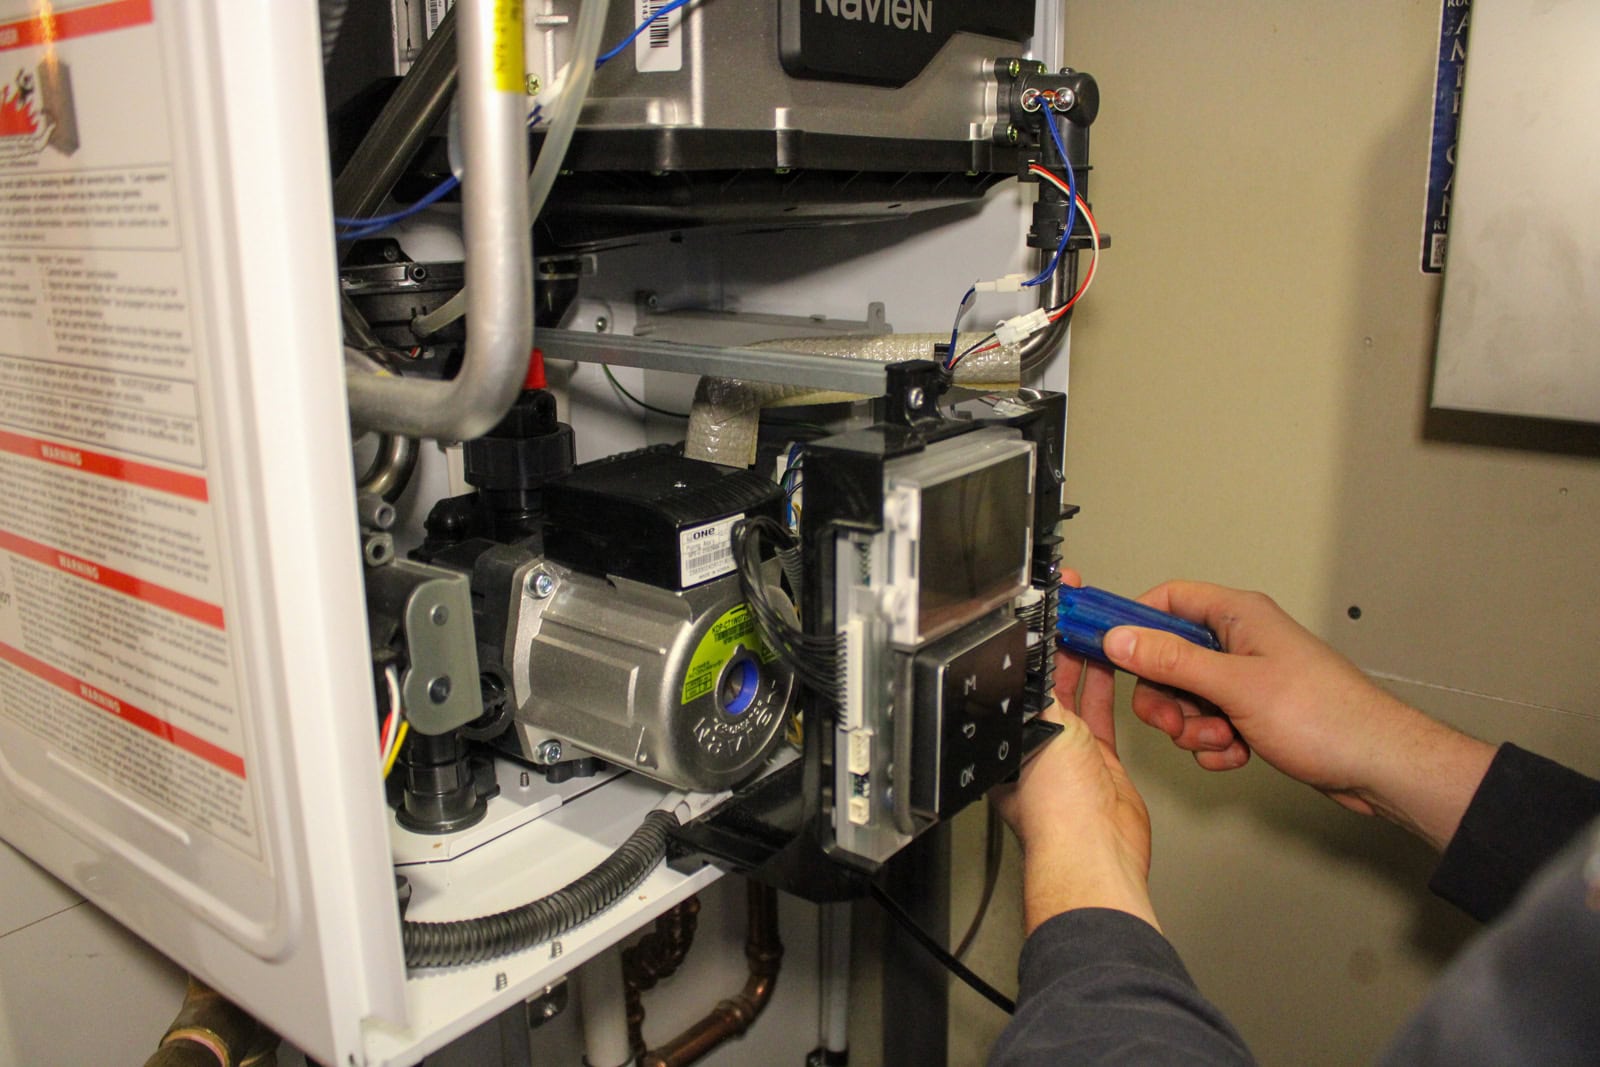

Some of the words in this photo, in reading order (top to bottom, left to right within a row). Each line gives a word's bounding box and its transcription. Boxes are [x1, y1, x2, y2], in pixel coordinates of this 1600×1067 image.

[41, 445, 82, 466] WARNING
[58, 555, 99, 579] WARNING
[80, 684, 121, 713] WARNING
[960, 764, 975, 788] OK
